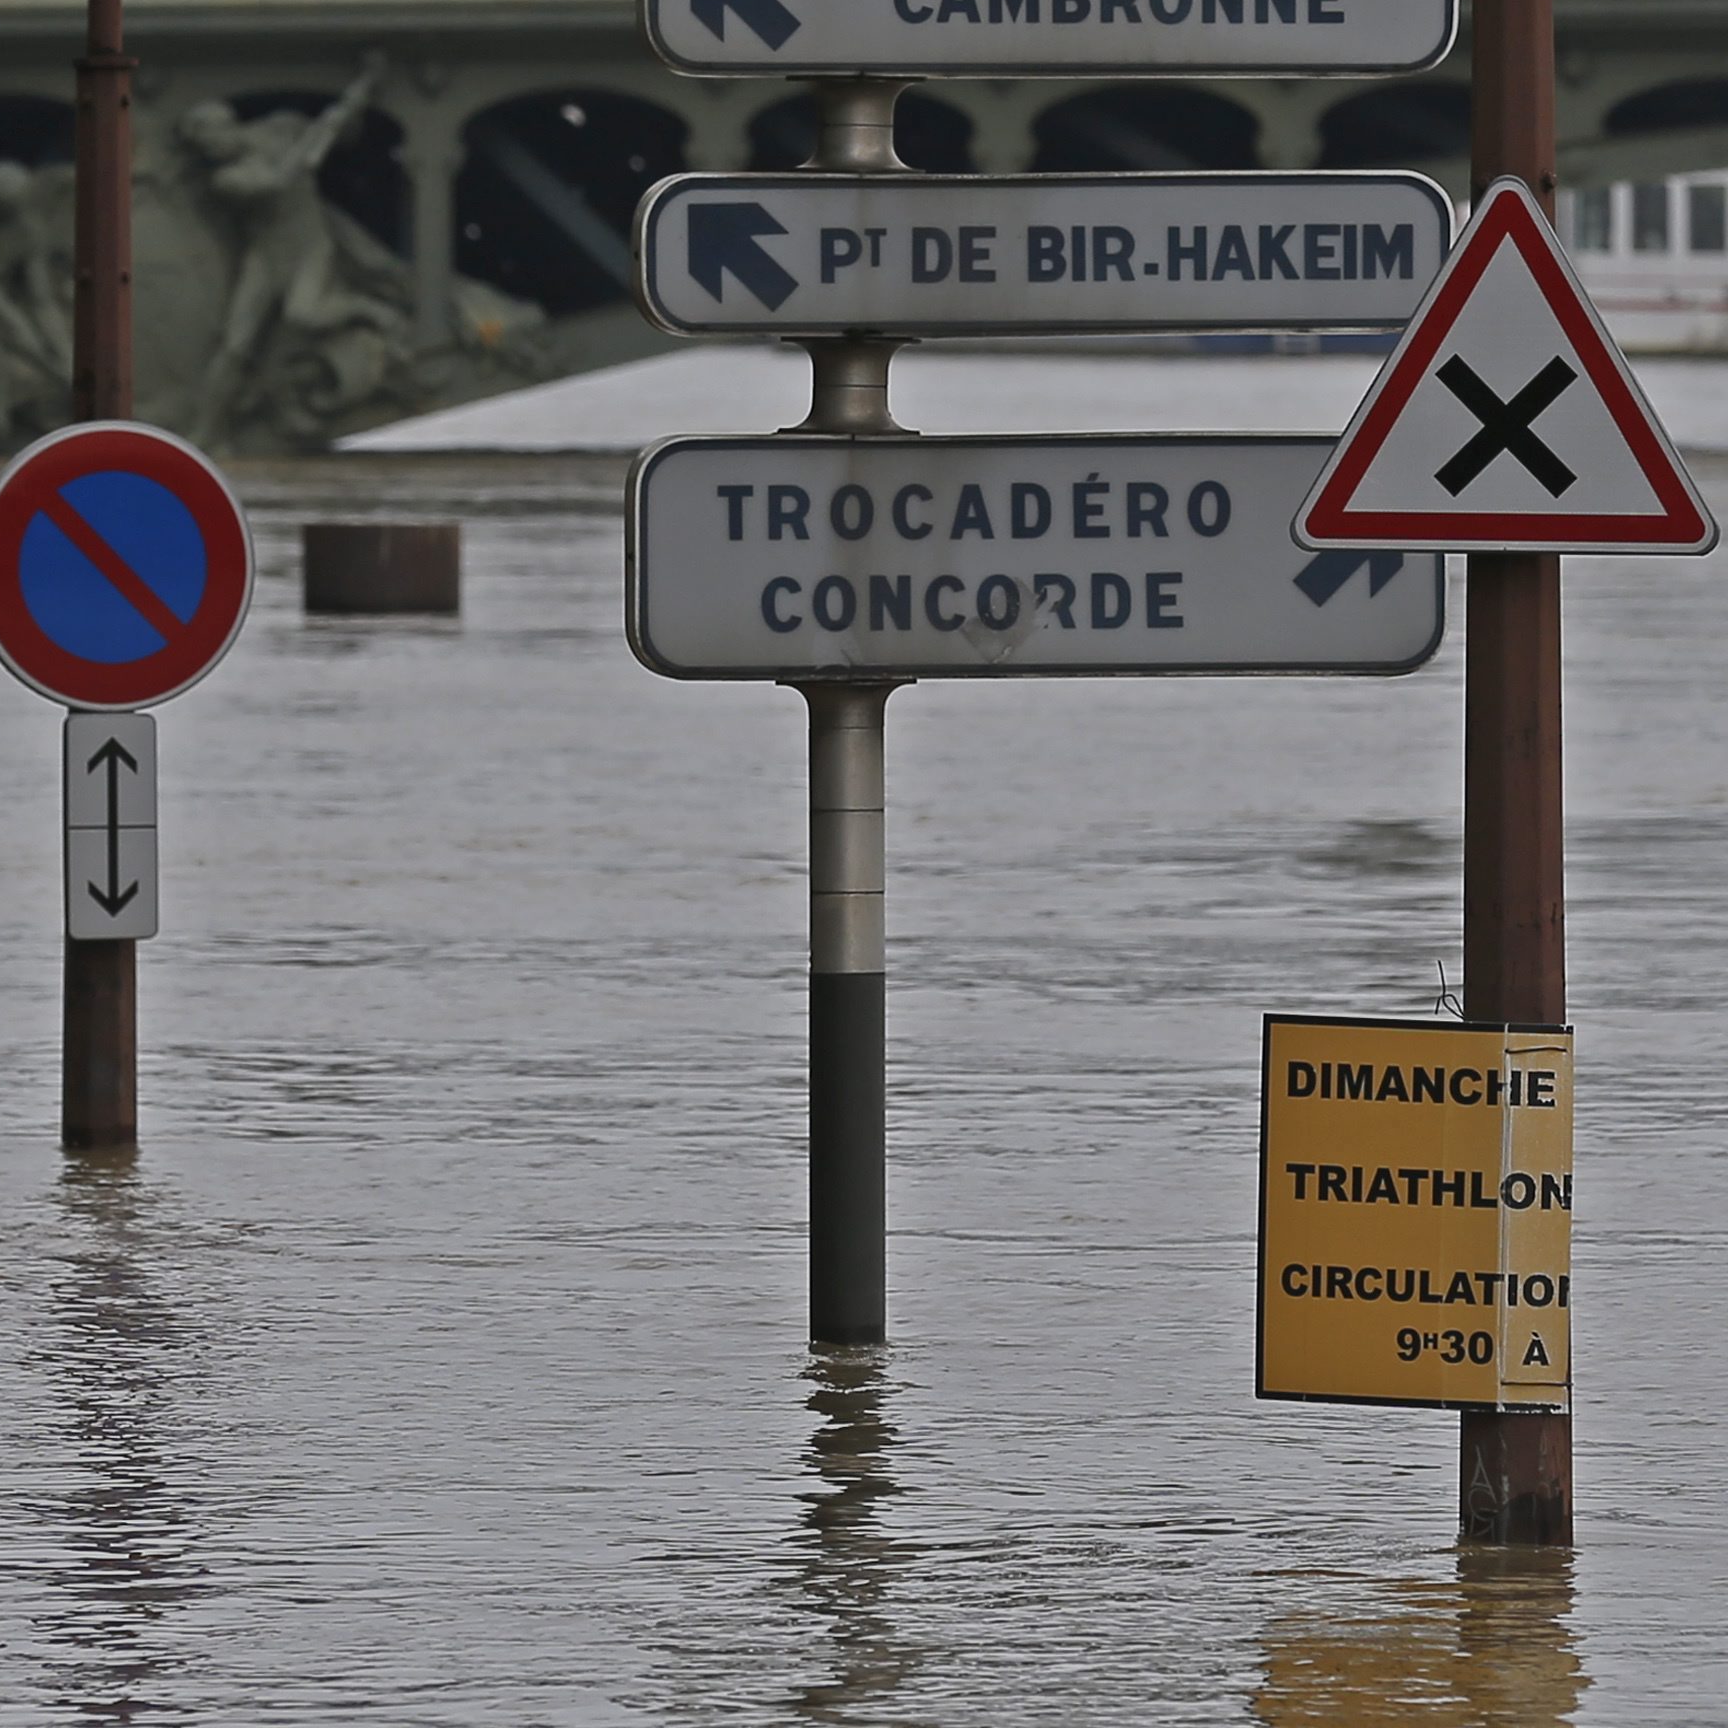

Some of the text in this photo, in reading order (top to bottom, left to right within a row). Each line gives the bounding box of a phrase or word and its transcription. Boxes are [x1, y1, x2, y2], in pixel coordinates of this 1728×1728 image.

[911, 225, 997, 284] DE
[716, 472, 1233, 542] TROCADÉRO
[760, 571, 1185, 634] CONCORDE
[1287, 1060, 1556, 1108] DIMANCHE
[1285, 1162, 1572, 1211] TRIATHLON
[1521, 1330, 1551, 1367] À
